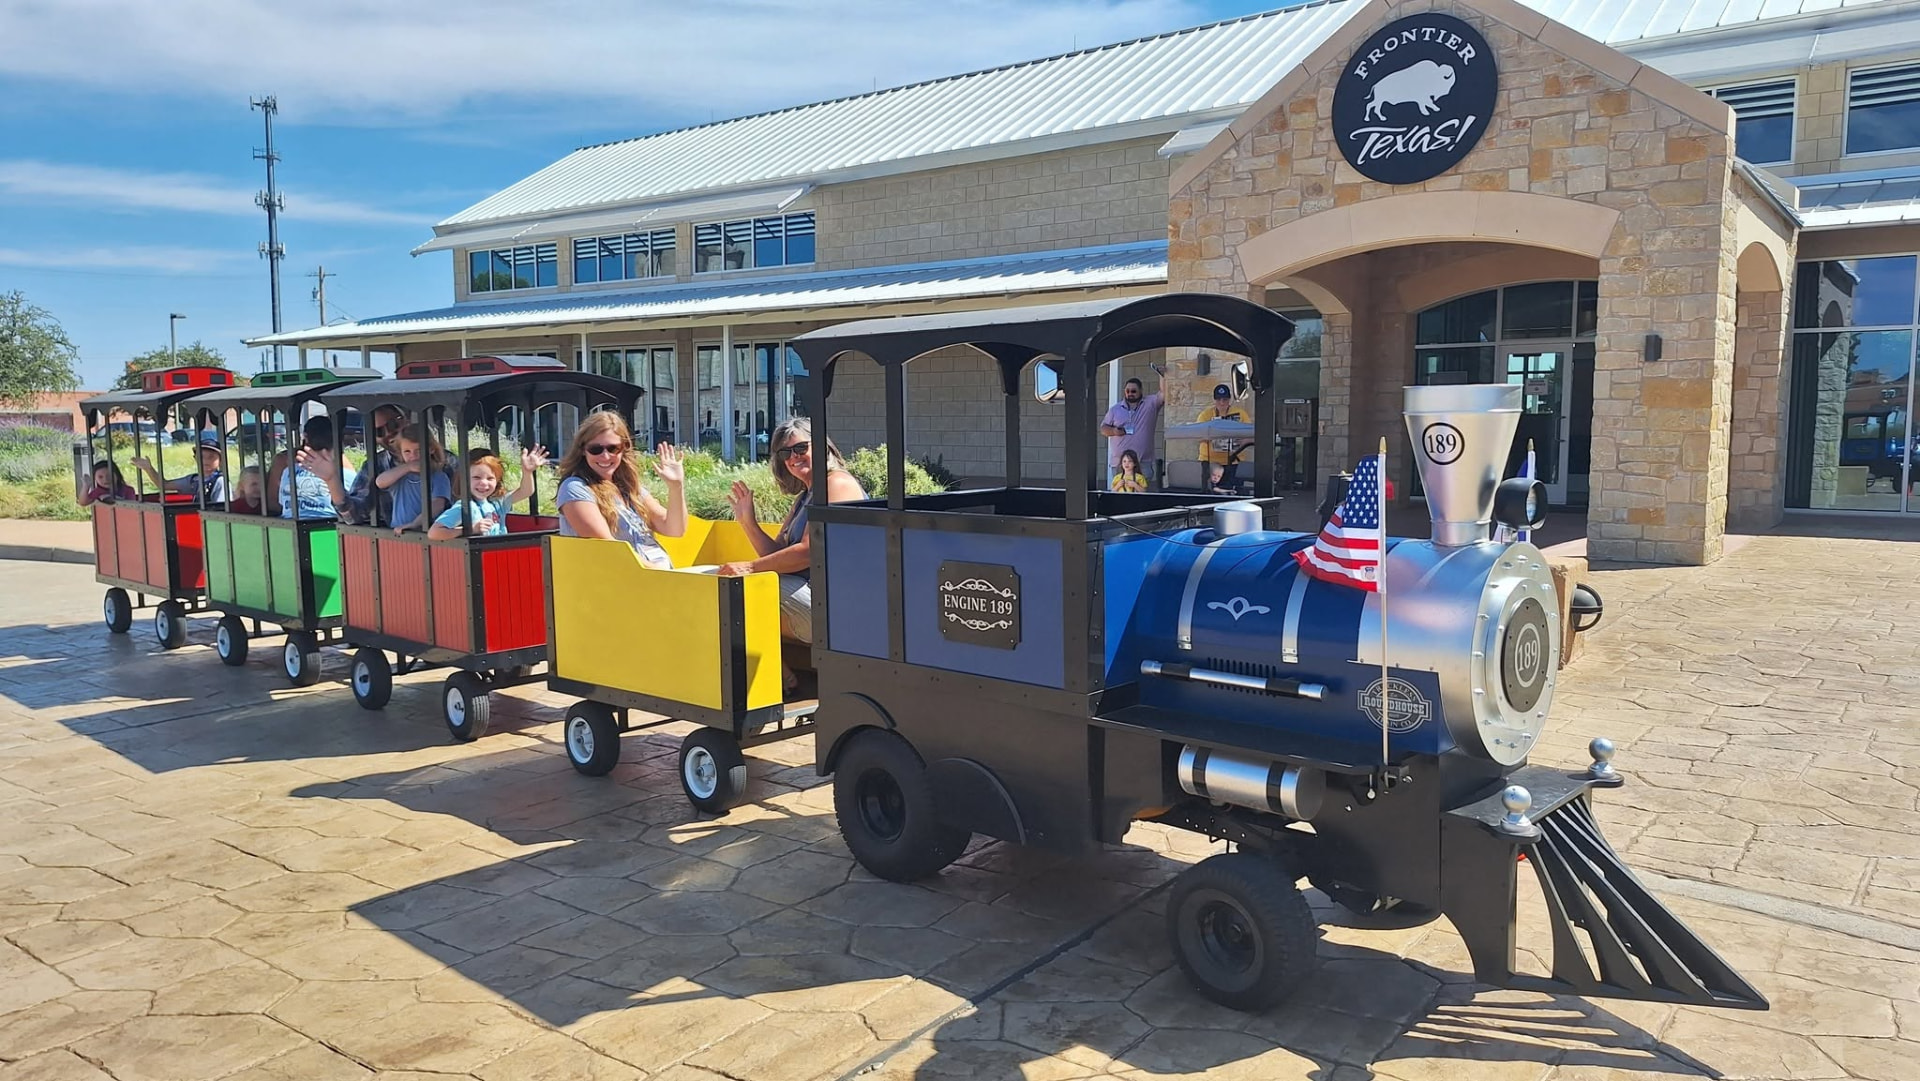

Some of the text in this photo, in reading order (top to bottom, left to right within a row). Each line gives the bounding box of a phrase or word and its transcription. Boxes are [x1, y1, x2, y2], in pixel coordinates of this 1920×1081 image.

[1354, 27, 1477, 80] FRONTIER
[1350, 115, 1477, 165] Texas!
[1427, 433, 1457, 454] 189
[944, 594, 1013, 615] ENGINE 189
[1517, 639, 1538, 672] 189
[1371, 683, 1416, 702] TRCKLESS
[1364, 696, 1425, 714] ROUDHOUSE
[1376, 715, 1398, 727] TIN
